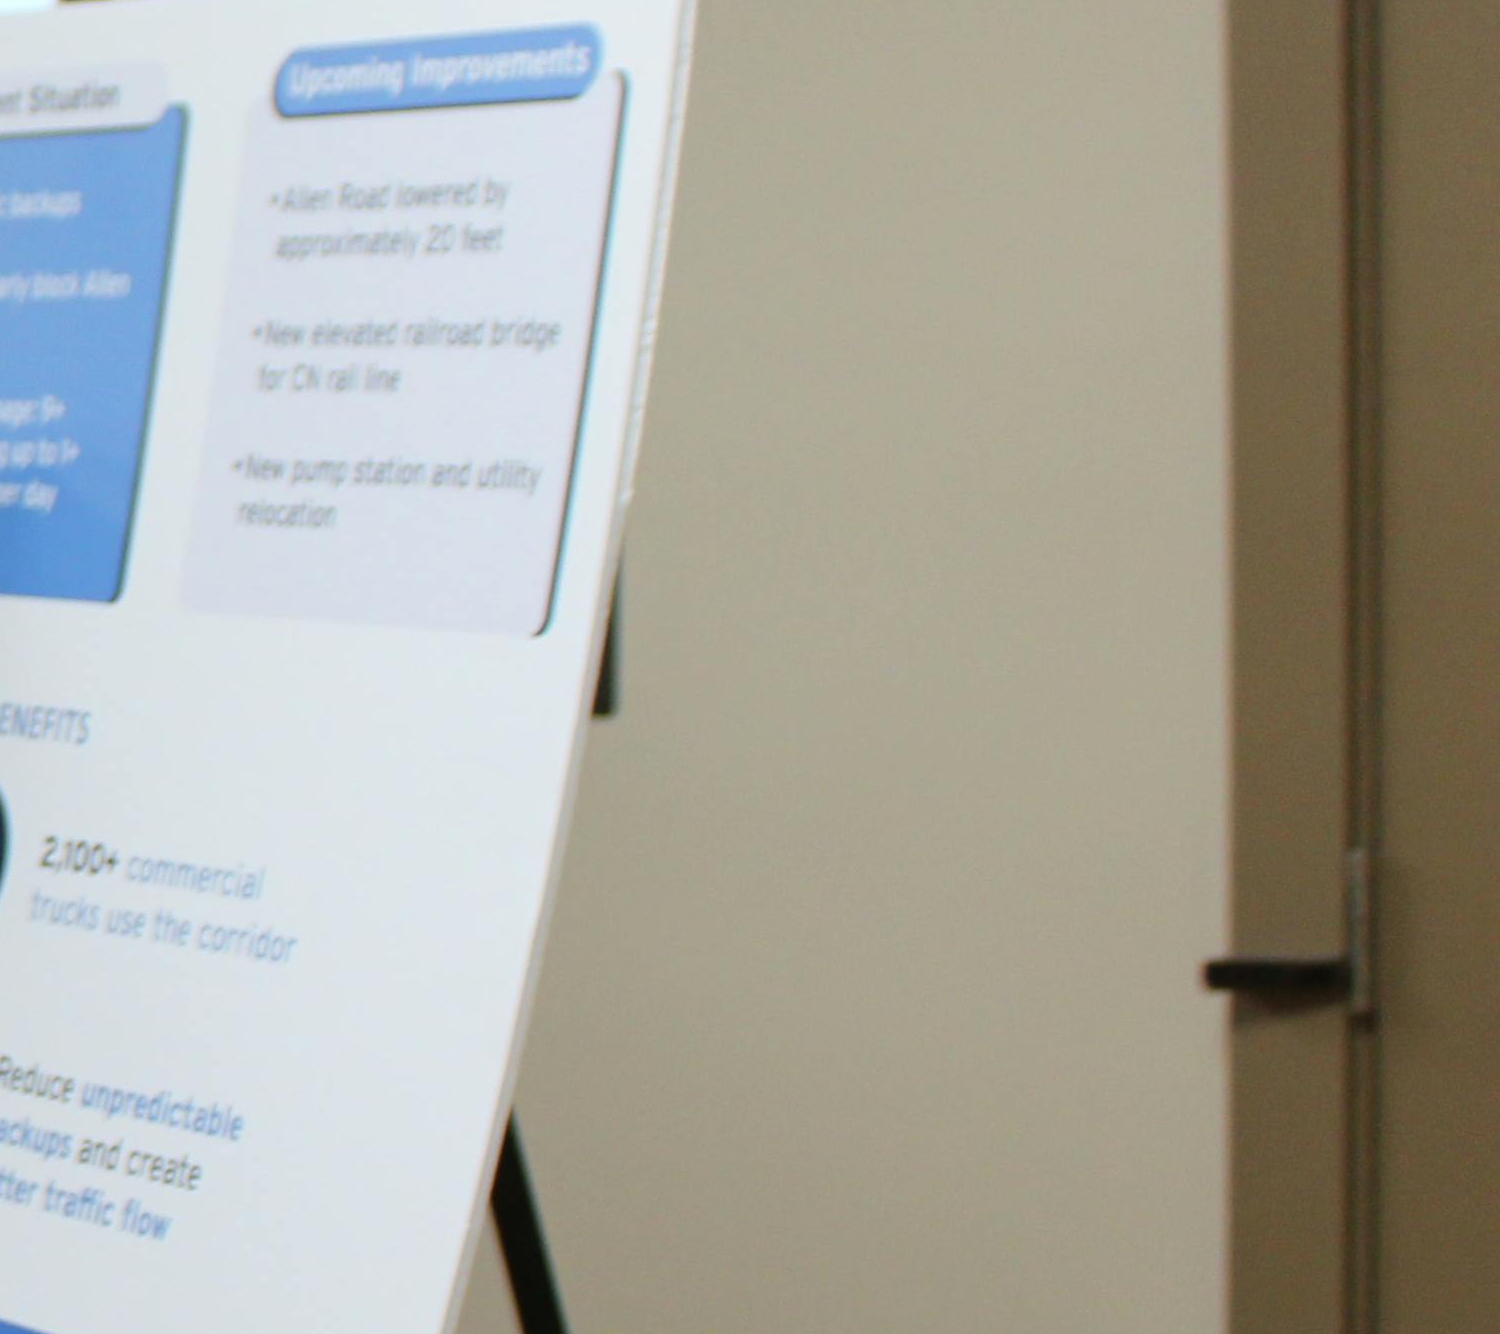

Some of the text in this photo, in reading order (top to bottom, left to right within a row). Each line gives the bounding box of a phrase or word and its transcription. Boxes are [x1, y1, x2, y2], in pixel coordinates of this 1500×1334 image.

[290, 42, 590, 99] Upcoming Improvements
[28, 84, 119, 114] Situation
[283, 177, 509, 211] Allen Road lowered by
[276, 225, 504, 260] approximately 20 feet
[264, 319, 561, 353] New elevated railroad bridge
[258, 365, 284, 392] for
[327, 365, 355, 391] rail
[364, 365, 400, 392] line
[245, 455, 541, 494] New pump station and utility
[238, 501, 336, 528] relocation
[39, 835, 267, 899] 2,100+ commercial
[31, 890, 298, 962] trucks use the corridor
[81, 1082, 244, 1141] unpredictable
[77, 1138, 124, 1170] and
[126, 1147, 202, 1192] create
[43, 1180, 115, 1227] traffic
[121, 1198, 173, 1242] flow
